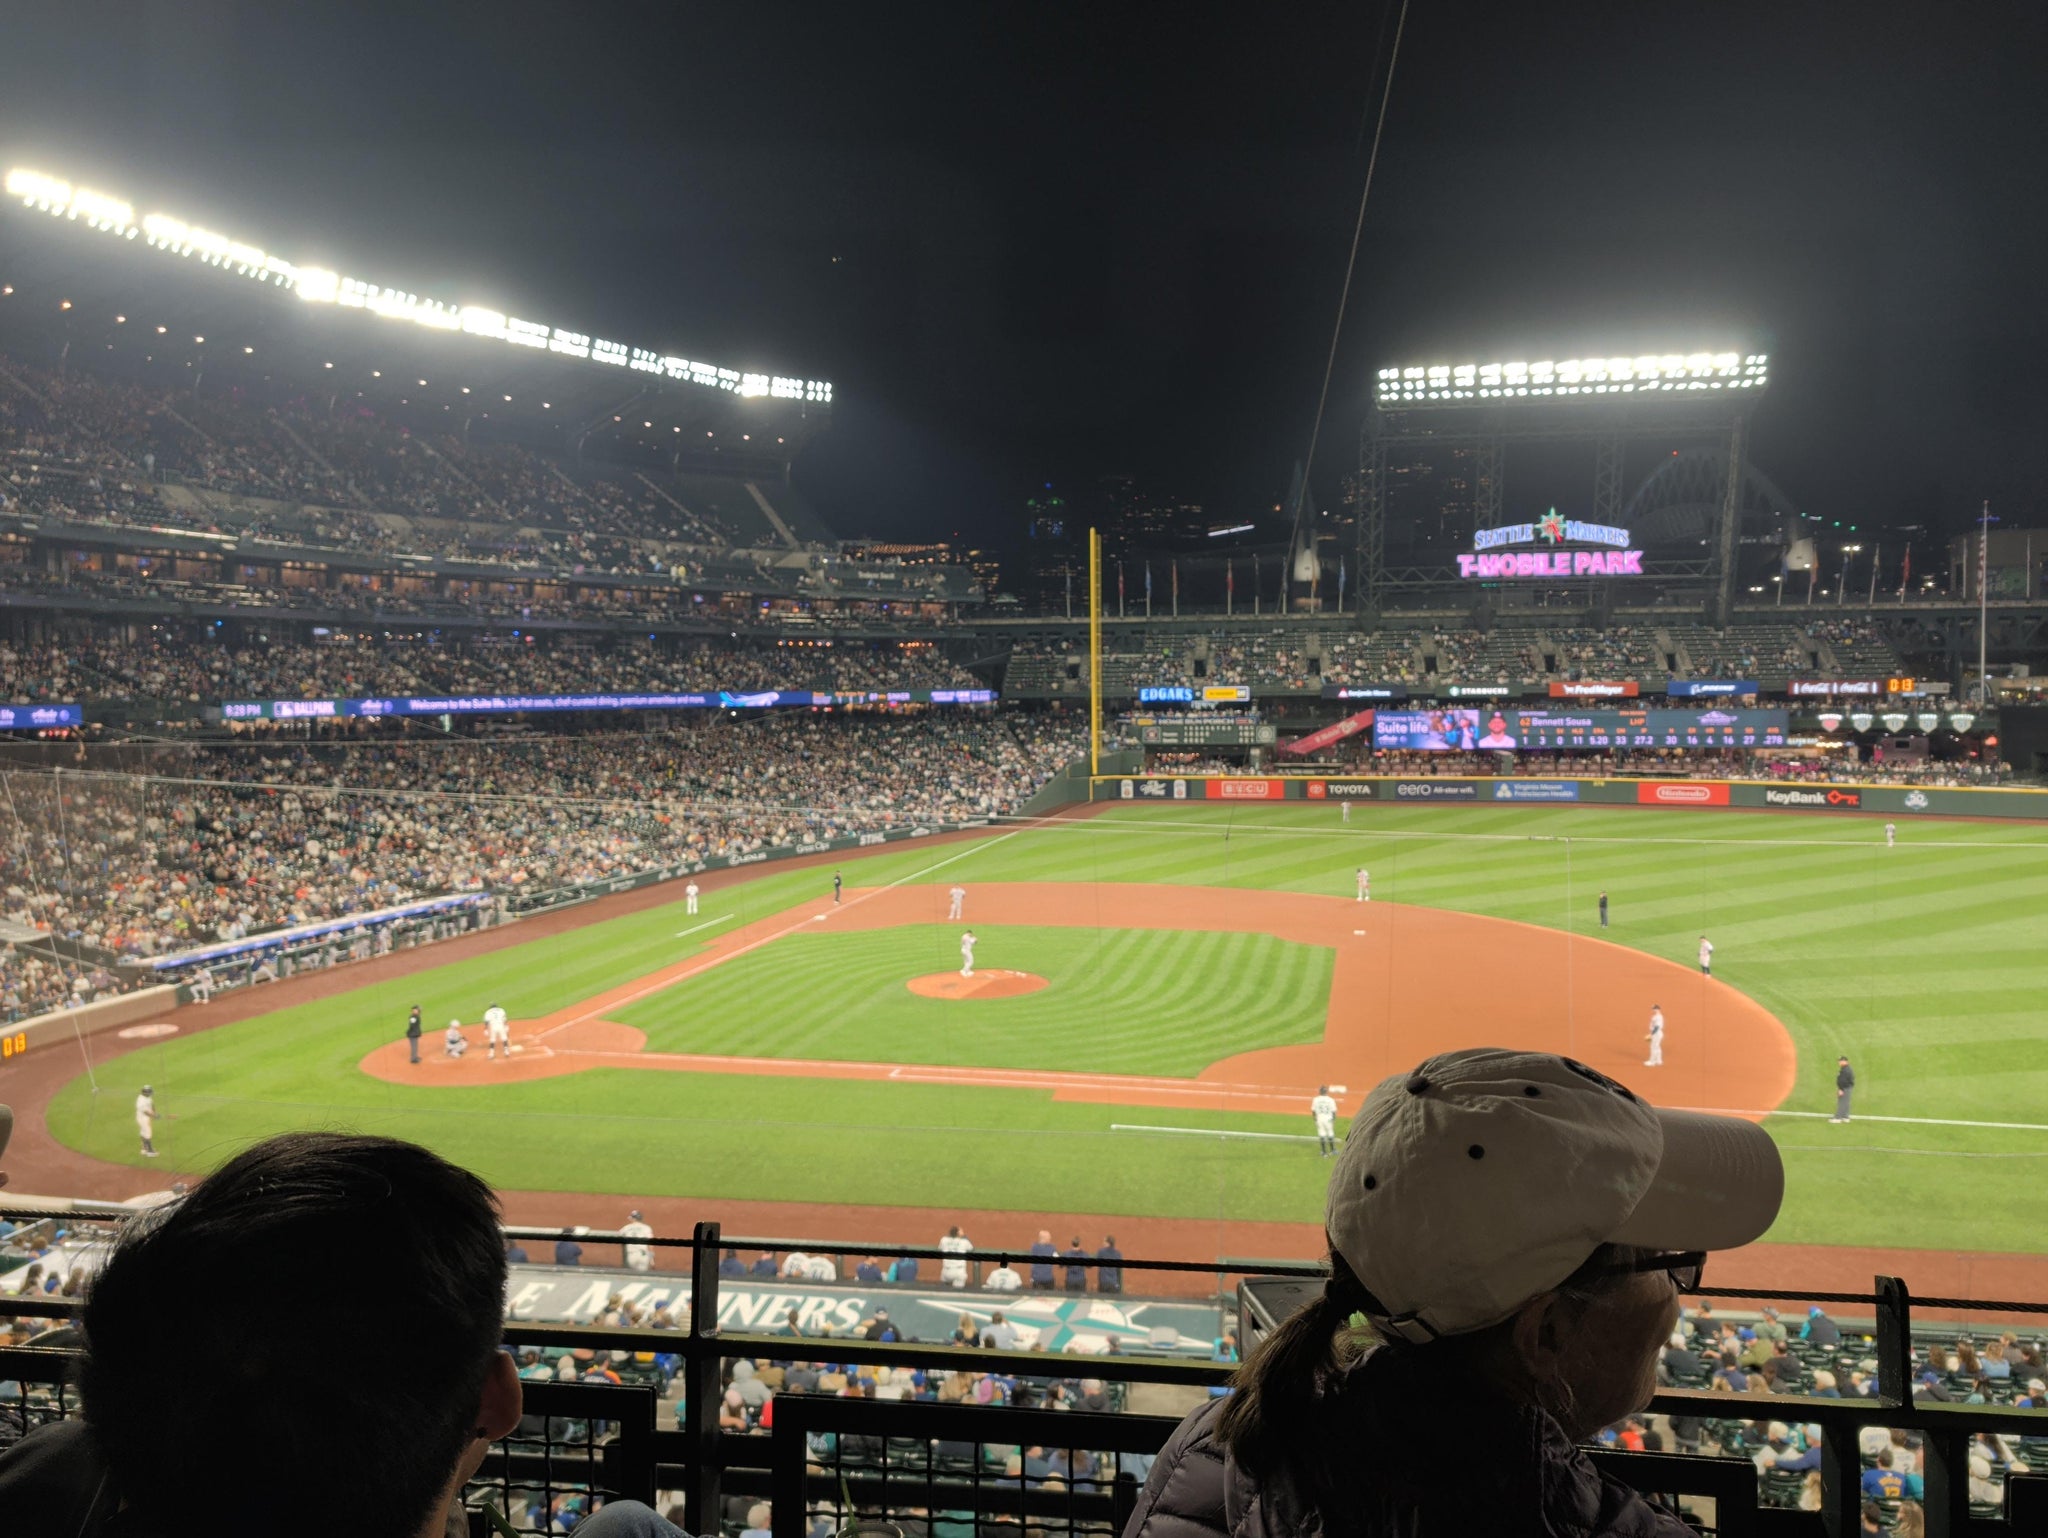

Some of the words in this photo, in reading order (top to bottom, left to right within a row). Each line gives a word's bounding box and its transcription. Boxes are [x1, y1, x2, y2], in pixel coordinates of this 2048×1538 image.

[1566, 520, 1630, 548] MARINERS
[1457, 553, 1571, 578] T-MOBILE
[1574, 551, 1644, 576] PARK
[1461, 687, 1509, 695] STARBUCKS
[294, 701, 336, 716] BALLPARK
[1377, 721, 1408, 734] Suite
[1410, 721, 1429, 734] life
[1665, 736, 1678, 745] 30
[1687, 736, 1698, 745] 16
[1705, 736, 1714, 745] 4
[1743, 736, 1755, 745] 27
[1328, 784, 1371, 795] TOYOTA
[1398, 784, 1431, 796] eero
[1767, 790, 1825, 805] KeyBank
